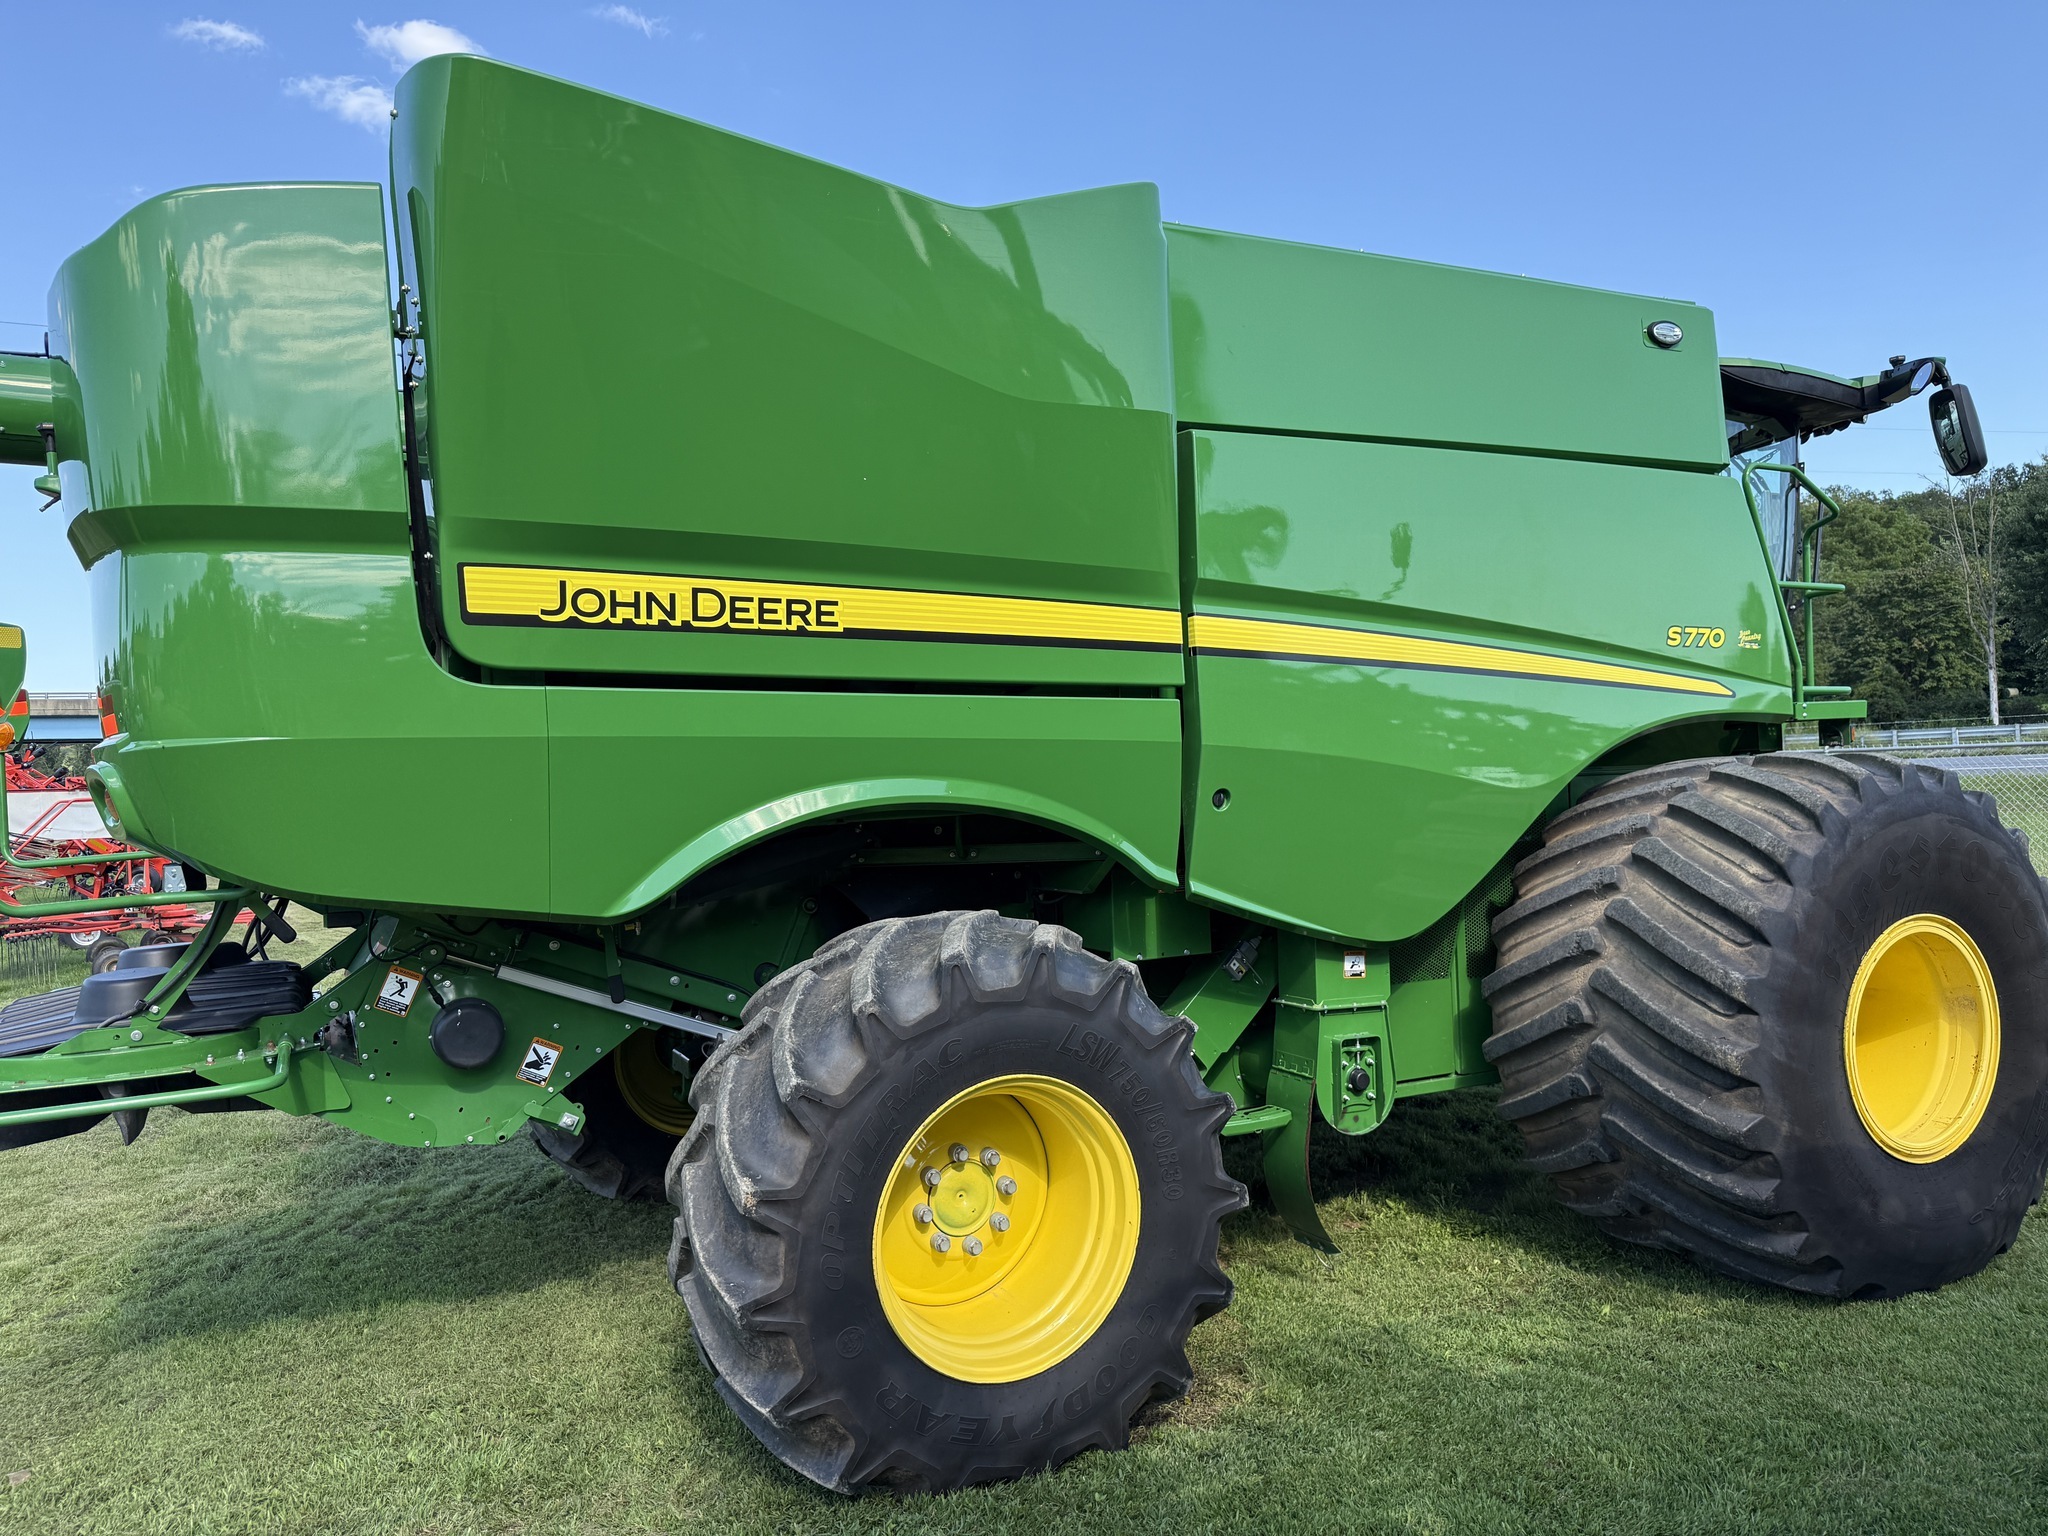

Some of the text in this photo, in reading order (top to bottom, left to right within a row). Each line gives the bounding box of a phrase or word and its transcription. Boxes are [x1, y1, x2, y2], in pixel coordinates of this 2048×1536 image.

[540, 579, 840, 628] JOHN DEERE
[1666, 625, 1726, 648] S770
[820, 1037, 964, 1291] OPTITRAC
